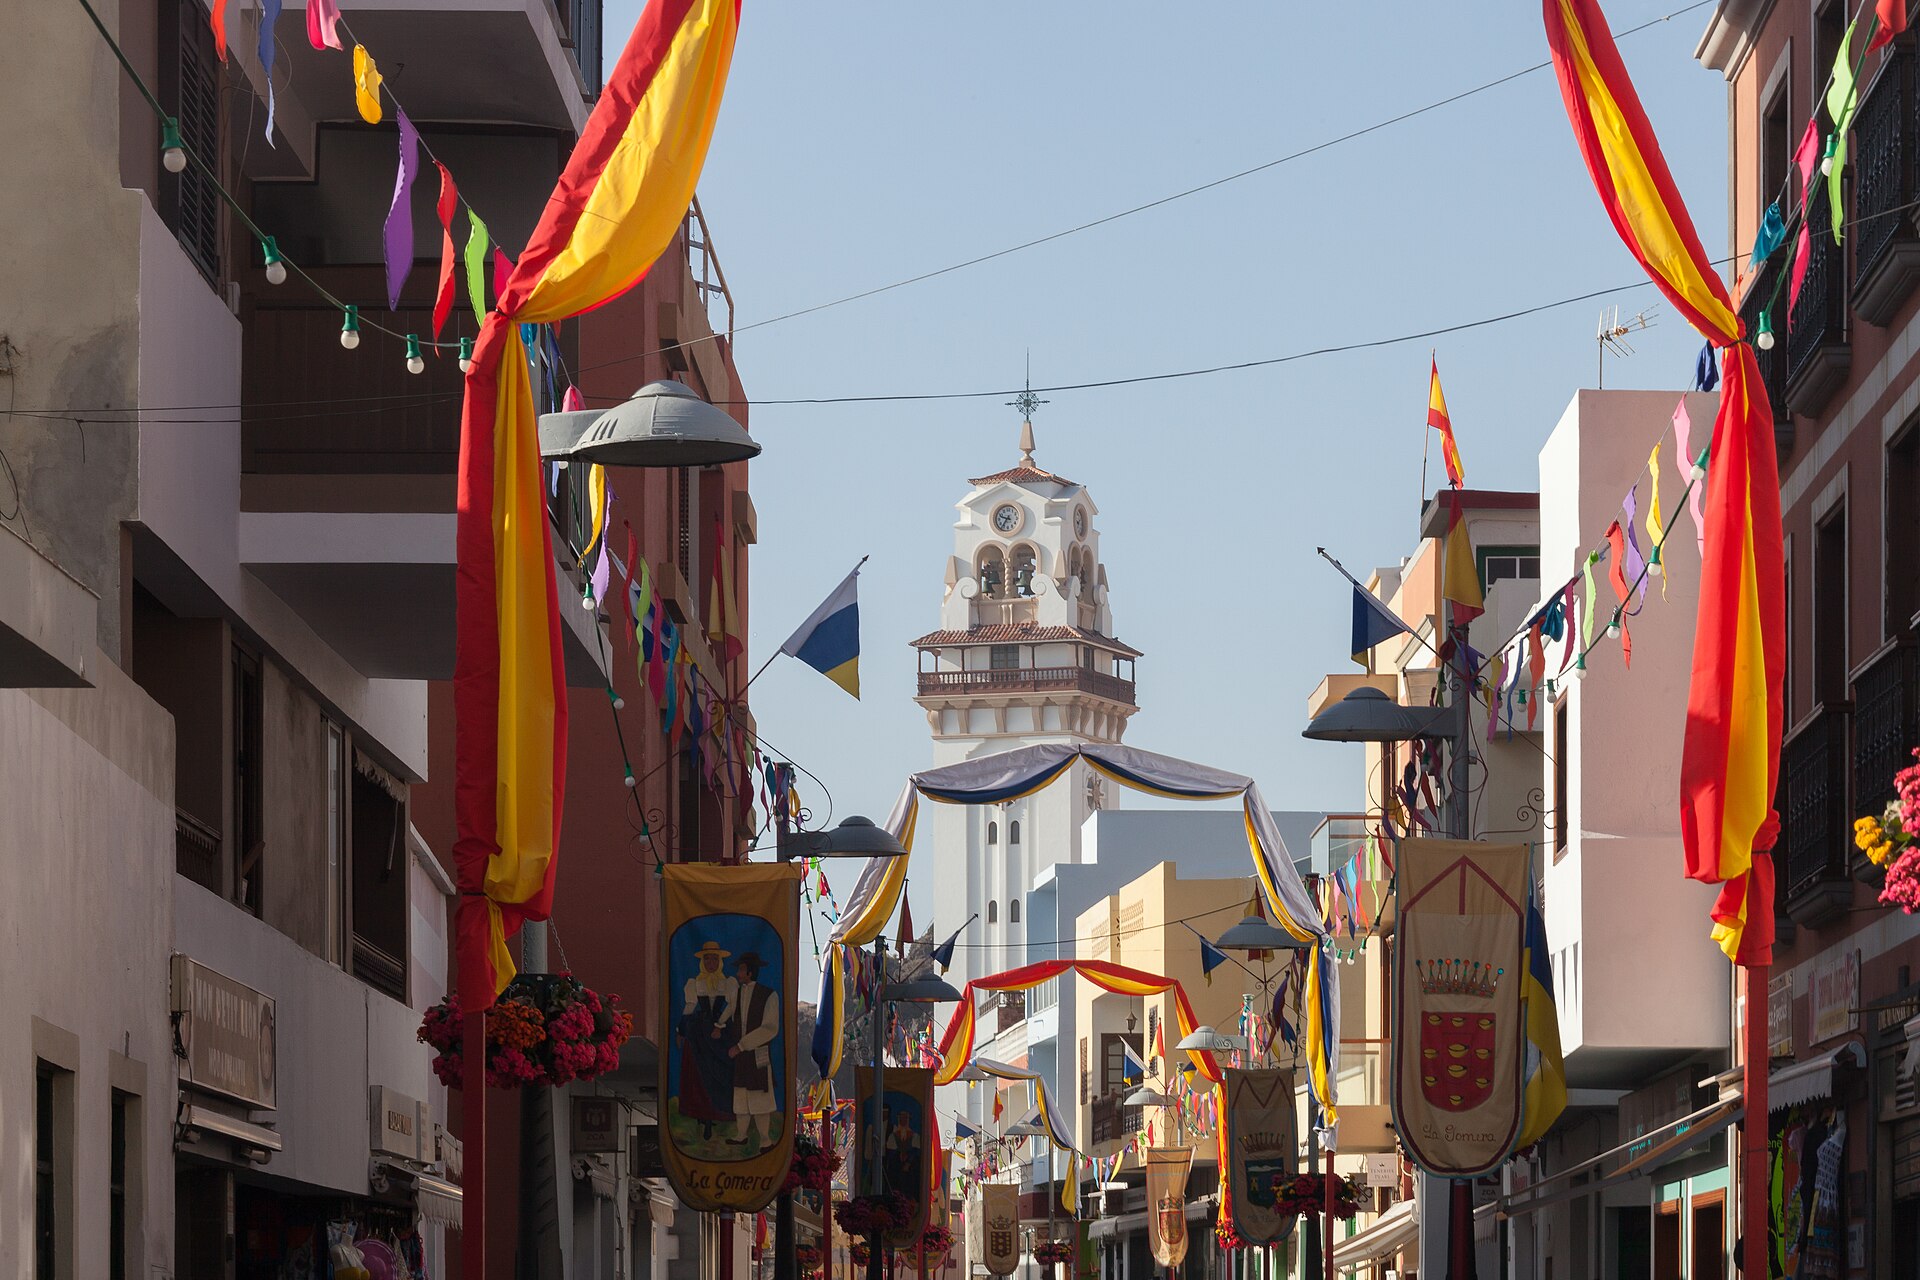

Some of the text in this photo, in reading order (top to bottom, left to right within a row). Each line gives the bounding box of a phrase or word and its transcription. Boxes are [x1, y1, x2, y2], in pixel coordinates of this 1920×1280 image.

[196, 978, 257, 1041] MON PETIT LION
[1422, 1123, 1497, 1142] La Gomera
[685, 1169, 774, 1199] La Gomera
[1481, 1188, 1496, 1196] ZCA
